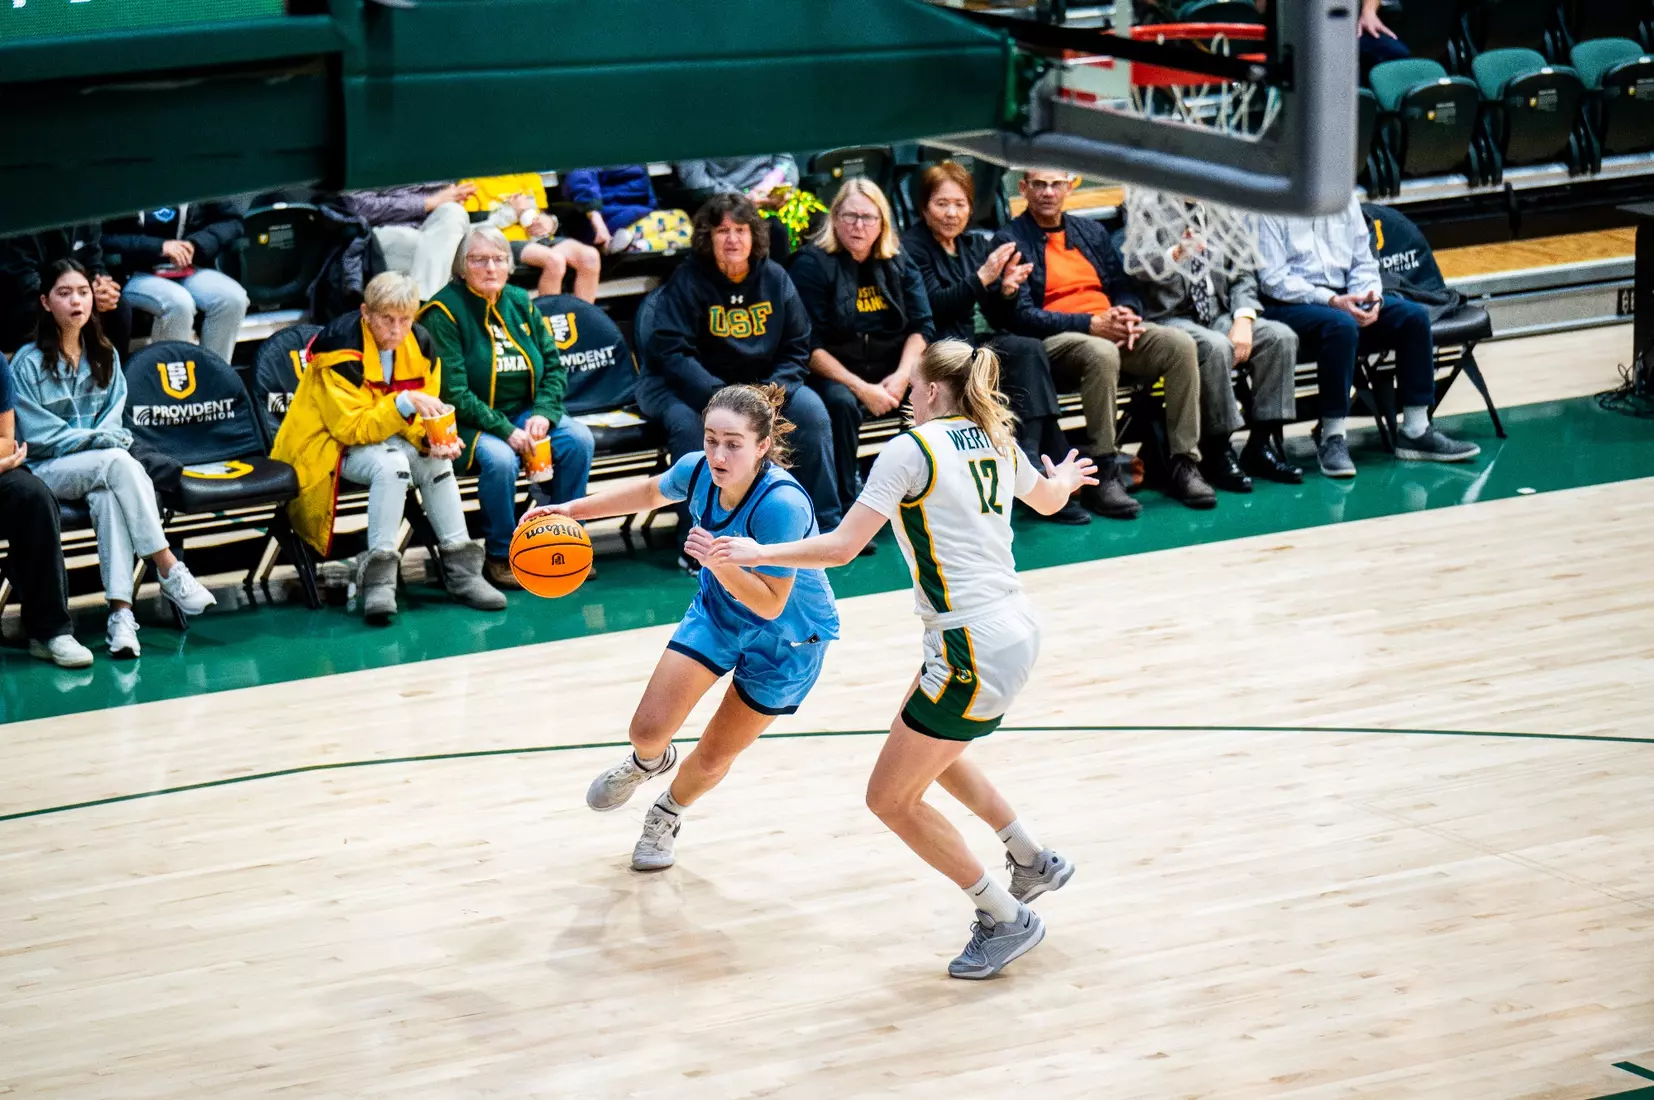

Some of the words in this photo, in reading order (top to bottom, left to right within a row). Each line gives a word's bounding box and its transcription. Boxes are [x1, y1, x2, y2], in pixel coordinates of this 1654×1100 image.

[1380, 249, 1417, 268] DENT
[709, 301, 773, 339] USF
[559, 345, 615, 367] VIDENT
[579, 358, 616, 373] UNION
[152, 398, 235, 419] PROVIDENT
[151, 416, 193, 427] CREDIT
[197, 411, 235, 423] UNION
[968, 457, 1003, 515] 12
[524, 523, 583, 541] Wilson
